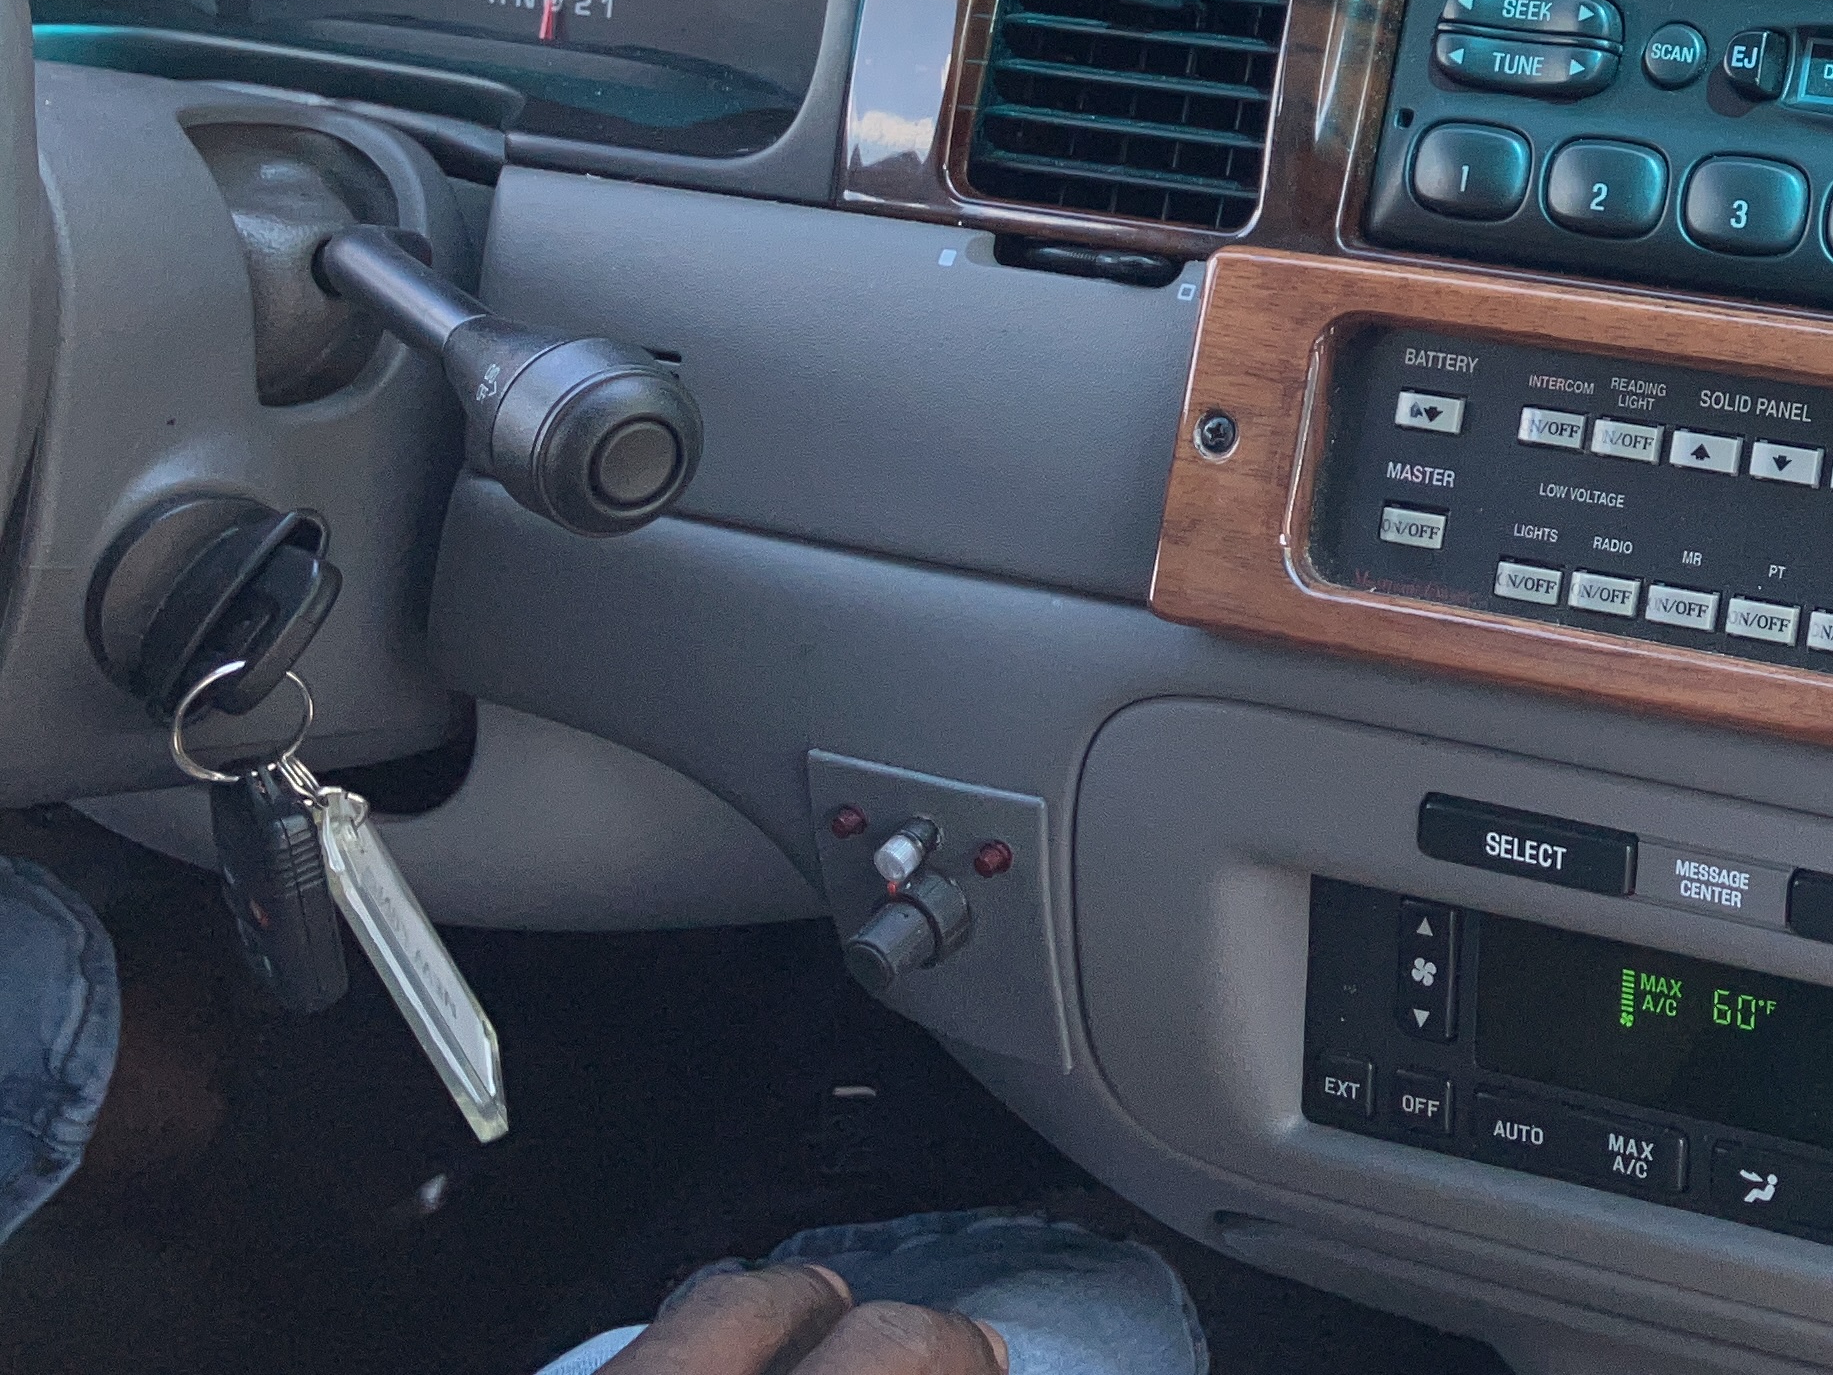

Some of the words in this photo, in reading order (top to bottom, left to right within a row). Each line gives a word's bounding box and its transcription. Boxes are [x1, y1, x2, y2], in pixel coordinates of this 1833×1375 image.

[1492, 51, 1545, 76] TUNE
[1650, 43, 1694, 64] SCAN
[1731, 46, 1759, 69] EJ
[1459, 163, 1470, 193] 1
[1590, 182, 1606, 212] 2
[1730, 199, 1748, 229] 3
[1404, 348, 1479, 373] BATTERY
[1528, 374, 1594, 395] INTERCOM
[1610, 377, 1667, 397] READING
[1618, 394, 1656, 411] LIGHT
[1700, 389, 1752, 415] SOLID
[1756, 398, 1812, 423] PANEL
[1526, 418, 1581, 439] N/OFF
[1386, 461, 1456, 488] MASTER
[1539, 483, 1569, 499] LOW
[1570, 487, 1625, 508] VOLTAGE
[1514, 523, 1558, 542] LIGHTS
[1593, 536, 1633, 554] RADIO
[1682, 550, 1702, 566] MR
[1768, 564, 1786, 579] PT
[1486, 832, 1567, 872] SELECT
[1675, 859, 1750, 890] MESSAGE
[1679, 879, 1742, 909] CENTER
[1640, 973, 1682, 999] MAX
[1642, 993, 1678, 1019] A/C
[1325, 1077, 1360, 1101] EXT
[1402, 1095, 1440, 1119] OFF
[1493, 1118, 1544, 1148] AUTO
[1608, 1132, 1654, 1162] MAX
[1612, 1154, 1650, 1181] A/C
